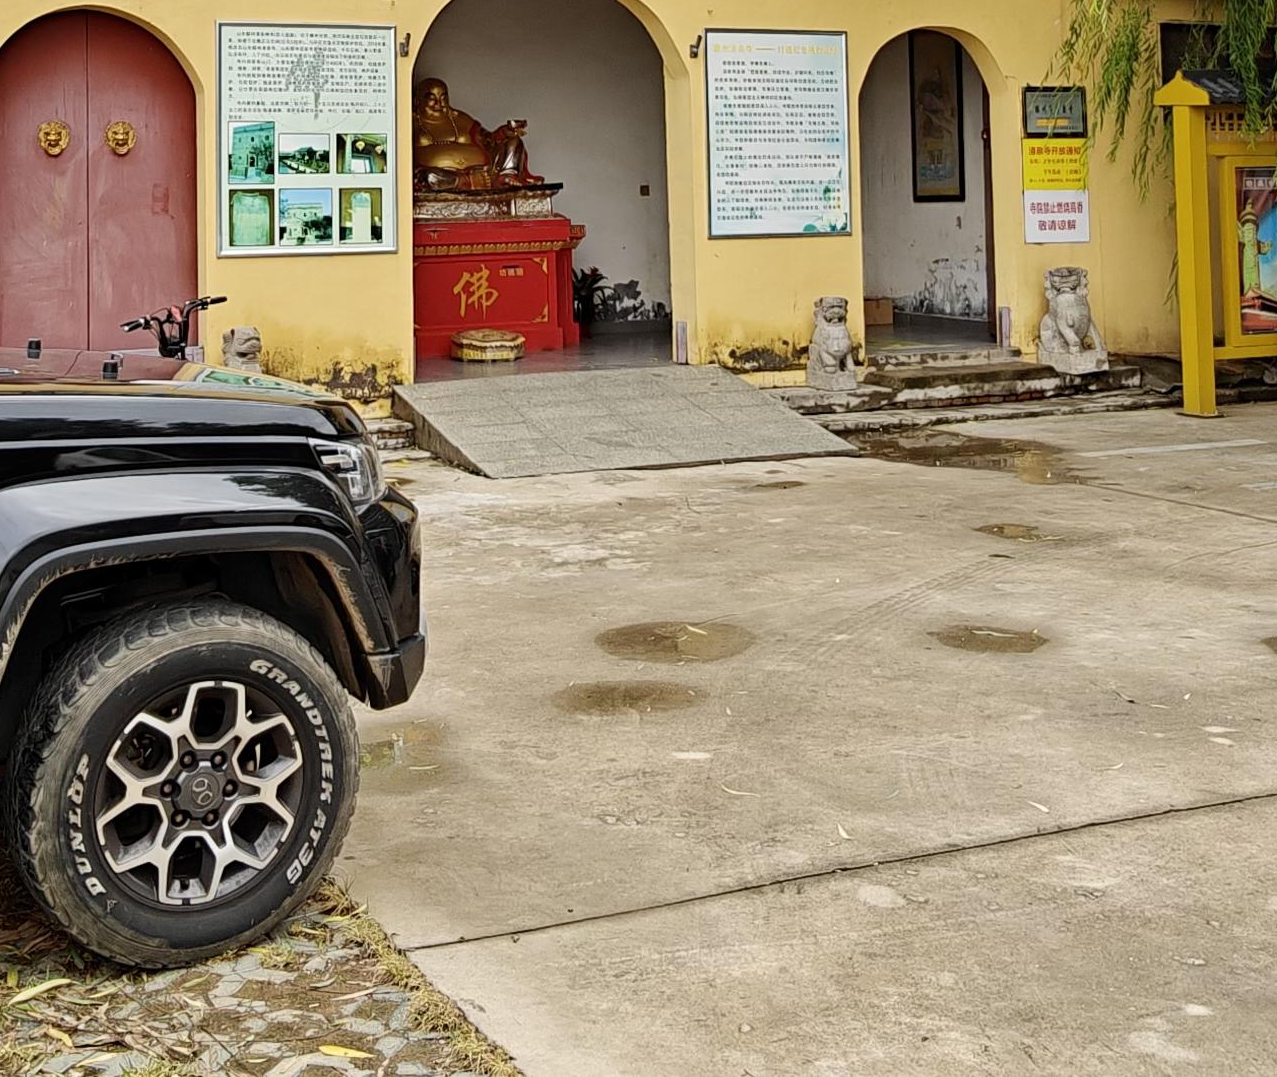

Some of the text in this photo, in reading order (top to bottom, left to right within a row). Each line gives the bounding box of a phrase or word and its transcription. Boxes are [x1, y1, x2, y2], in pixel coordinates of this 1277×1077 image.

[453, 263, 499, 321] 佛
[249, 659, 334, 804] GRANDTREK
[67, 753, 108, 897] DUNLOP
